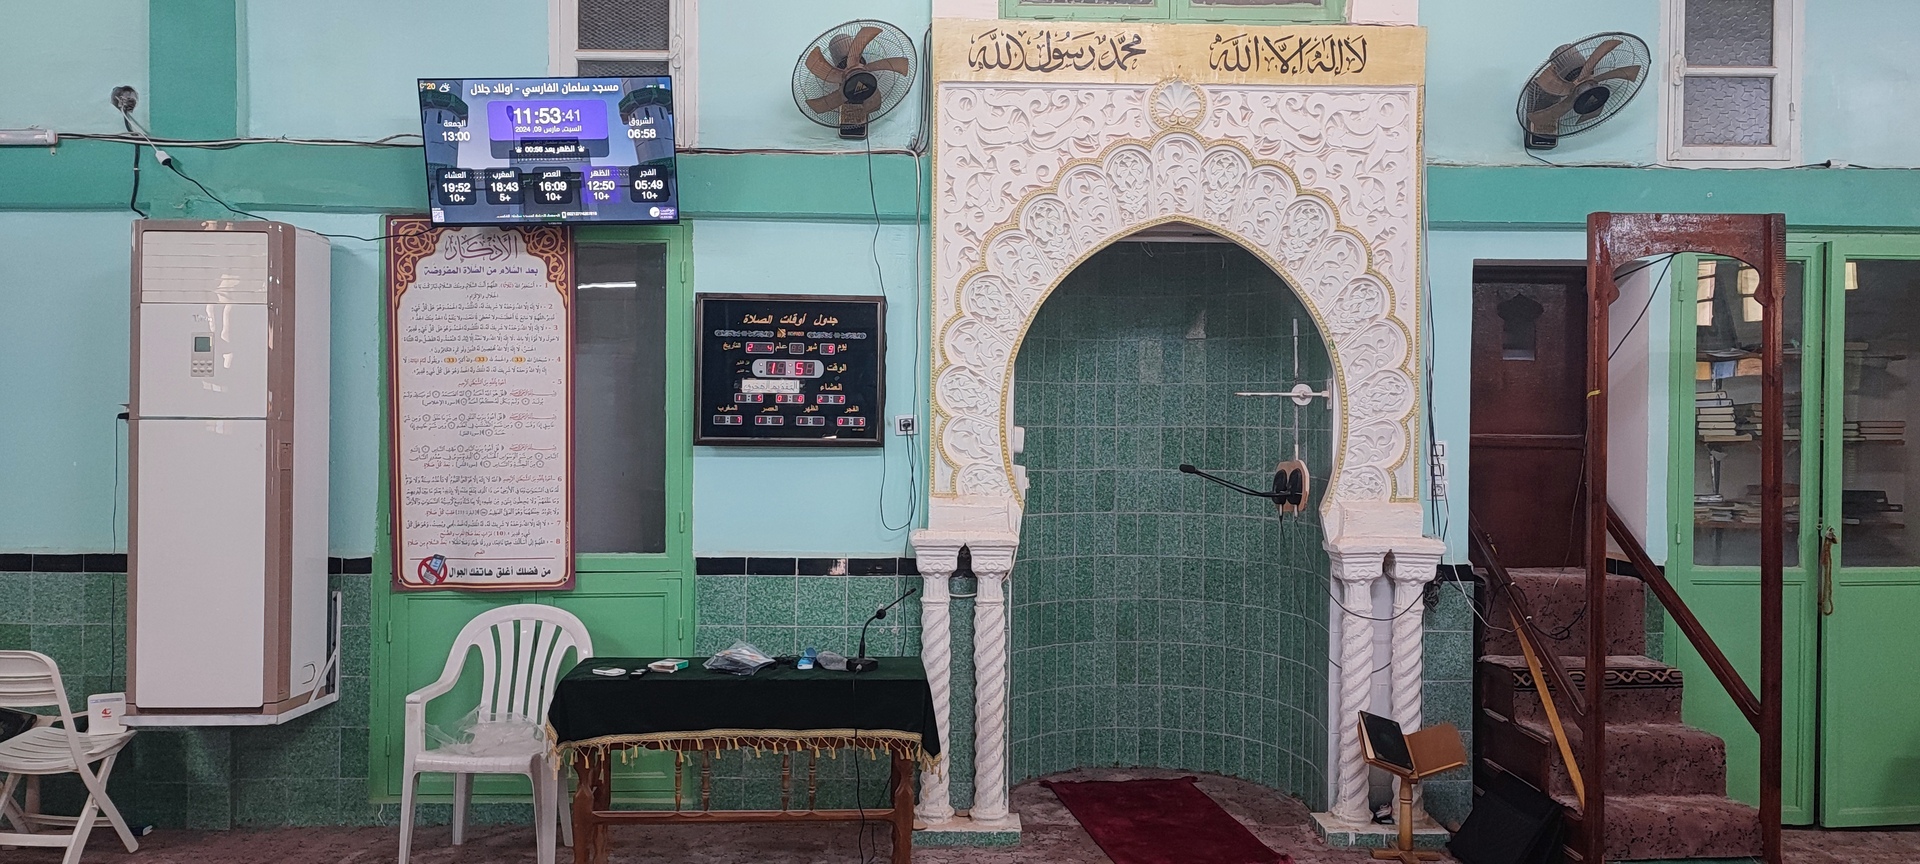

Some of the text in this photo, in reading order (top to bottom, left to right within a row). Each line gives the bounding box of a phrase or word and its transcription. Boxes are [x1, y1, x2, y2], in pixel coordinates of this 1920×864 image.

[1024, 30, 1095, 72] رسول
[1098, 34, 1146, 71] محمد
[1209, 33, 1259, 73] الله
[1344, 34, 1367, 74] لا
[470, 83, 491, 96] جلال
[522, 82, 559, 98] الفارسي
[562, 82, 590, 97] سلمان
[592, 84, 619, 96] مسجد
[513, 106, 581, 124] 11:53:41
[443, 119, 467, 128] الجمعة
[629, 117, 654, 127] الشروق
[544, 126, 560, 136] مارس
[627, 129, 656, 139] 06:58
[441, 132, 470, 141] 13:00
[544, 146, 556, 154] بعد
[556, 145, 576, 154] الظهر
[444, 171, 467, 179] العشاء
[492, 171, 515, 181] المغرب
[542, 170, 561, 180] العصر
[590, 169, 610, 179] الظهر
[640, 169, 657, 178] الفجر
[442, 183, 471, 193] 19:52
[490, 182, 519, 192] 18:43
[539, 181, 567, 191] 16:09
[587, 181, 615, 191] 12:50
[634, 180, 663, 190] 05:49
[486, 267, 497, 276] من
[525, 267, 539, 276] بعد
[743, 314, 773, 324] الصلاة
[813, 314, 838, 326] جدول
[722, 342, 741, 350] التاريخ
[775, 341, 788, 352] عام
[806, 342, 818, 352] شهر
[837, 343, 847, 353] يوم
[827, 363, 847, 373] الوقت
[820, 383, 842, 392] العشاء
[449, 566, 551, 578] من فضلك أغلق هاتفك الجوال
